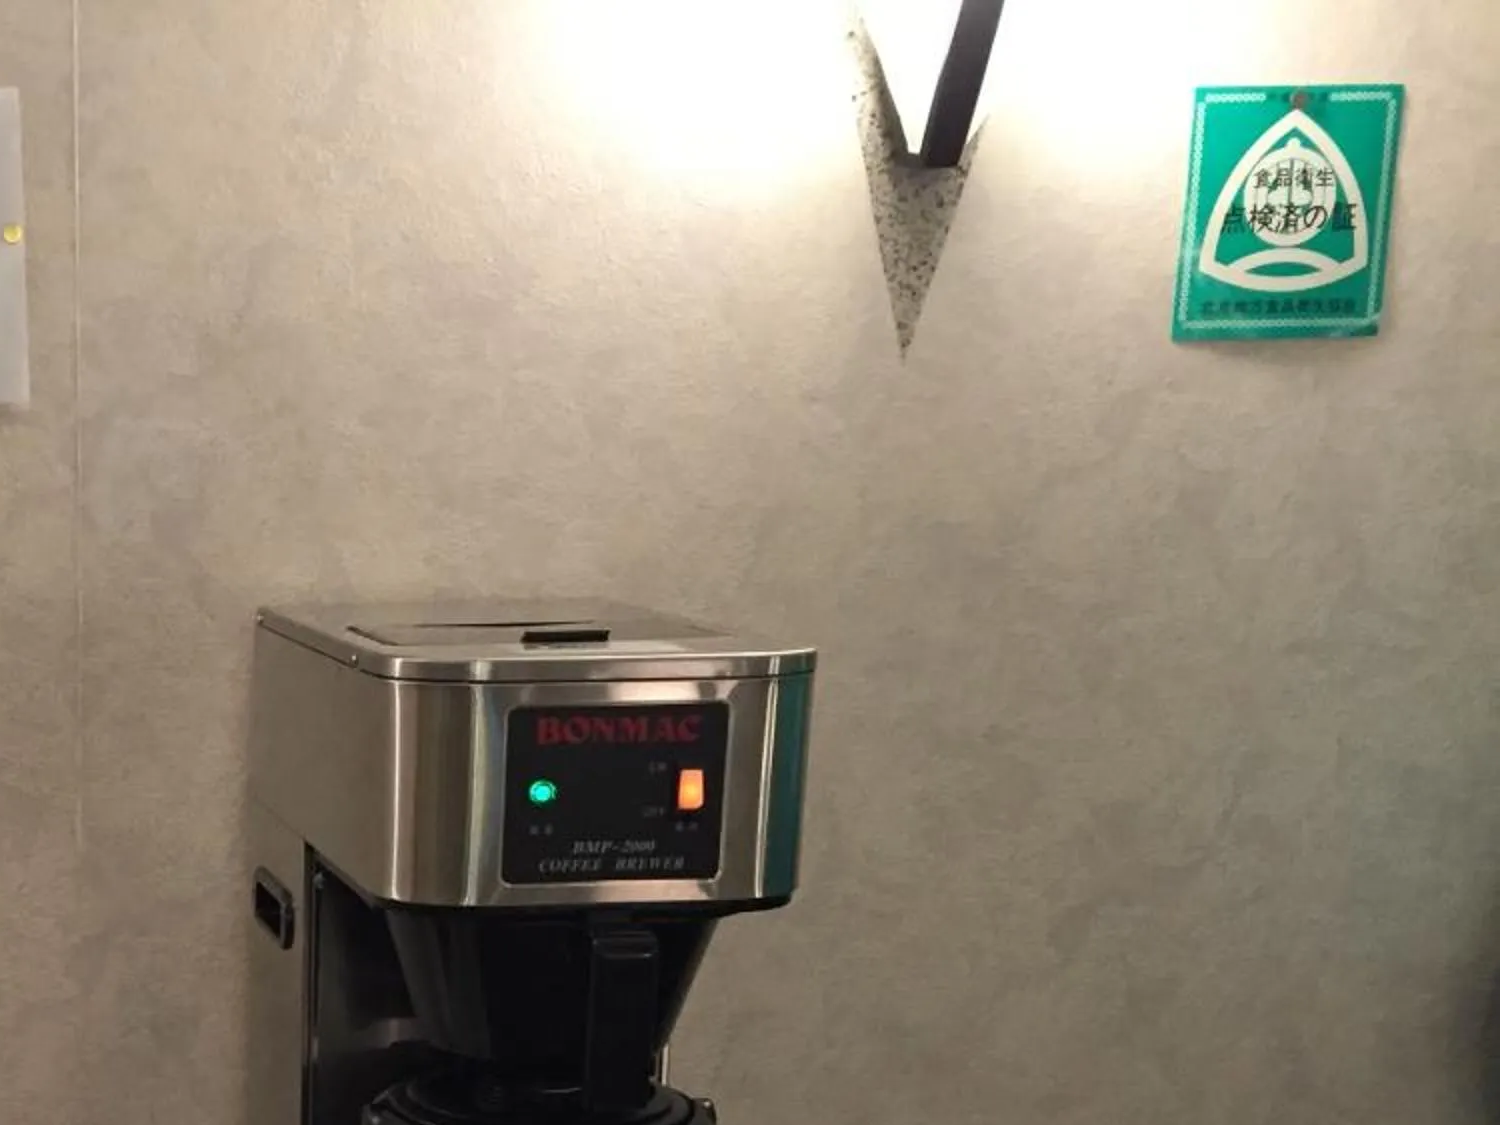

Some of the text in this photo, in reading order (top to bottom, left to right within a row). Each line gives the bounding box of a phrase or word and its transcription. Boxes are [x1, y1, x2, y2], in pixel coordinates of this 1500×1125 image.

[1253, 167, 1335, 189] 食品衛生
[1221, 202, 1358, 234] 点検済の証
[536, 713, 703, 745] BONMAC
[537, 856, 686, 873] COFFEE BREWER
